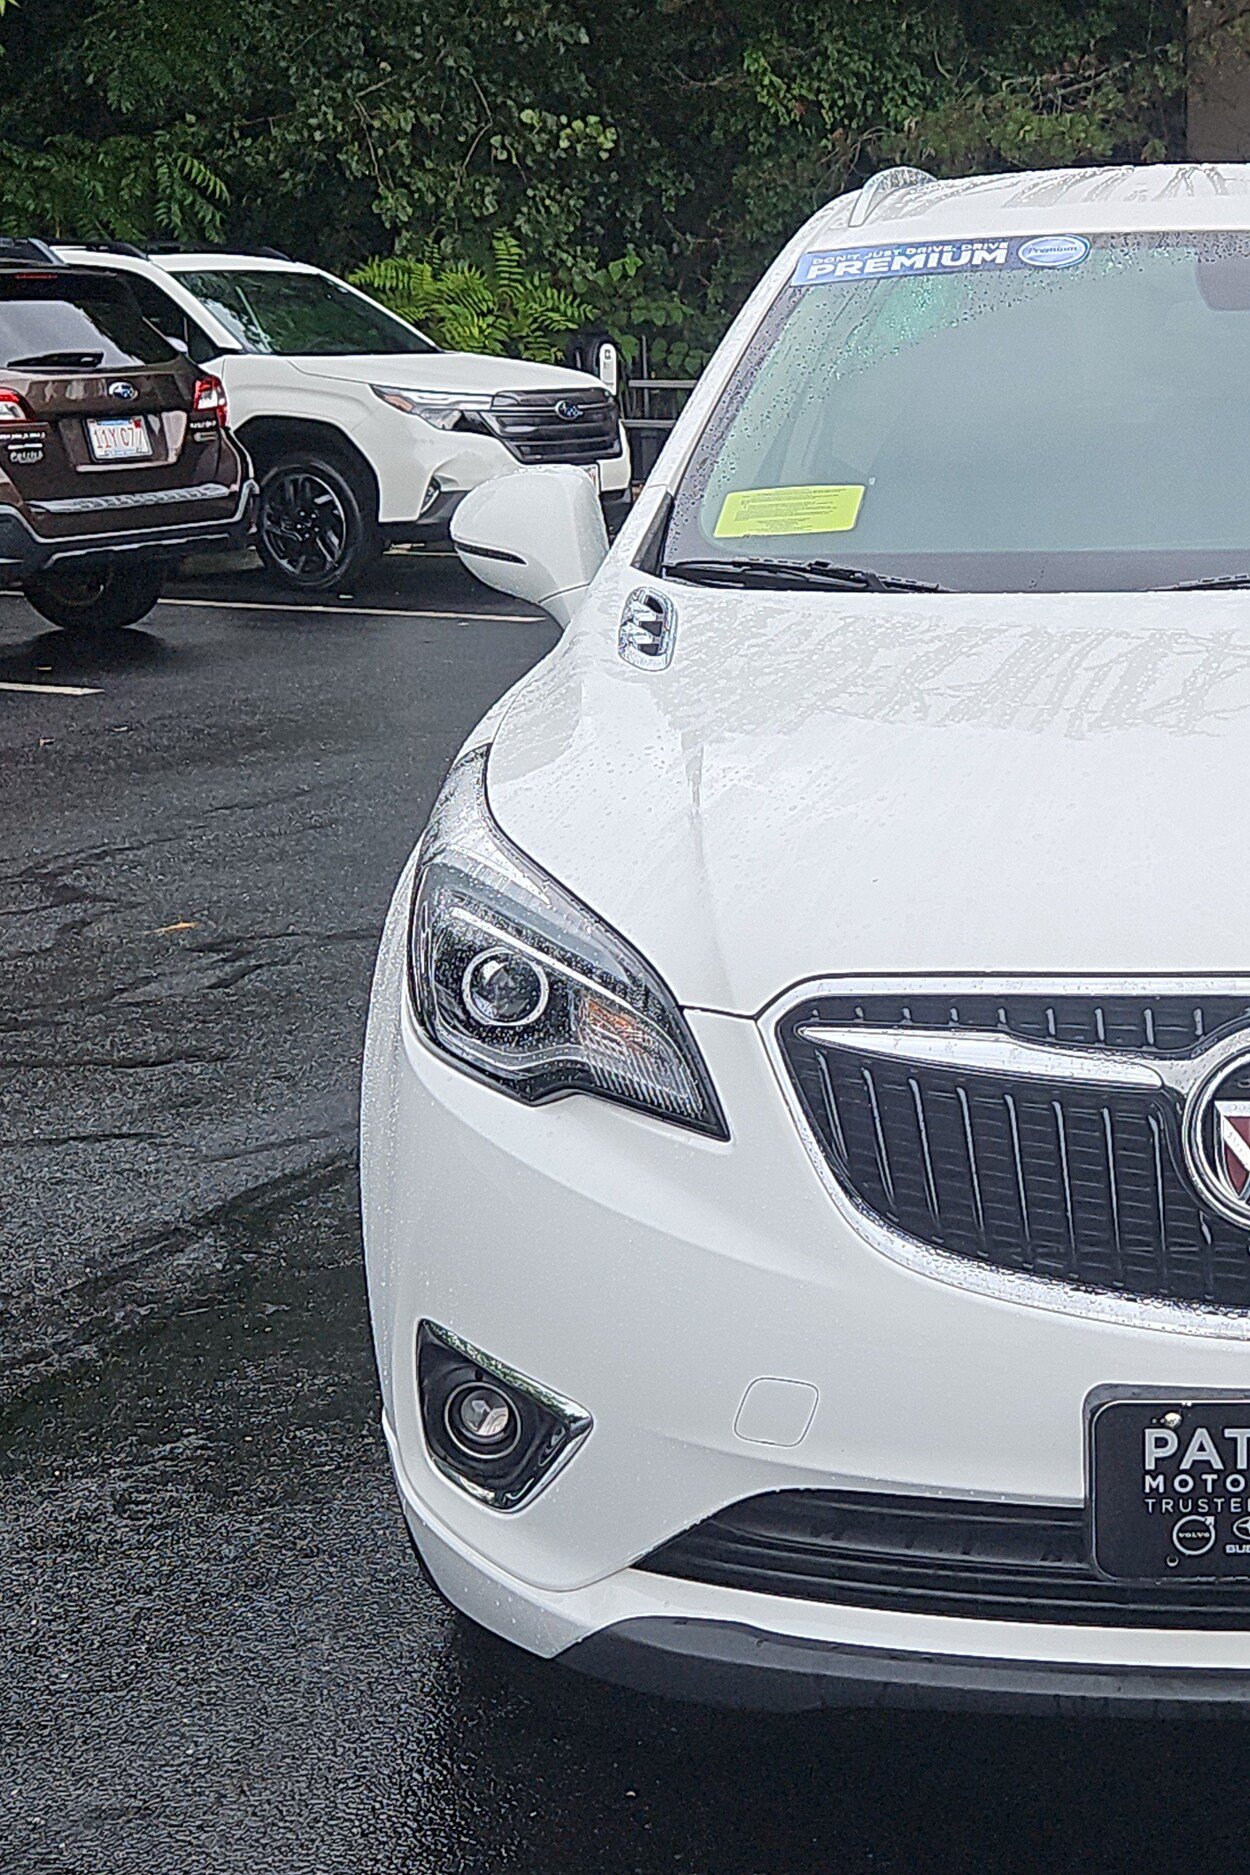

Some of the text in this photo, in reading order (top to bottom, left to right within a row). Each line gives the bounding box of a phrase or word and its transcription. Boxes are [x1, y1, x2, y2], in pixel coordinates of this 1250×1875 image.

[863, 248, 902, 260] JUST
[961, 242, 1009, 251] DRIVE
[806, 248, 1007, 279] PREMIUM
